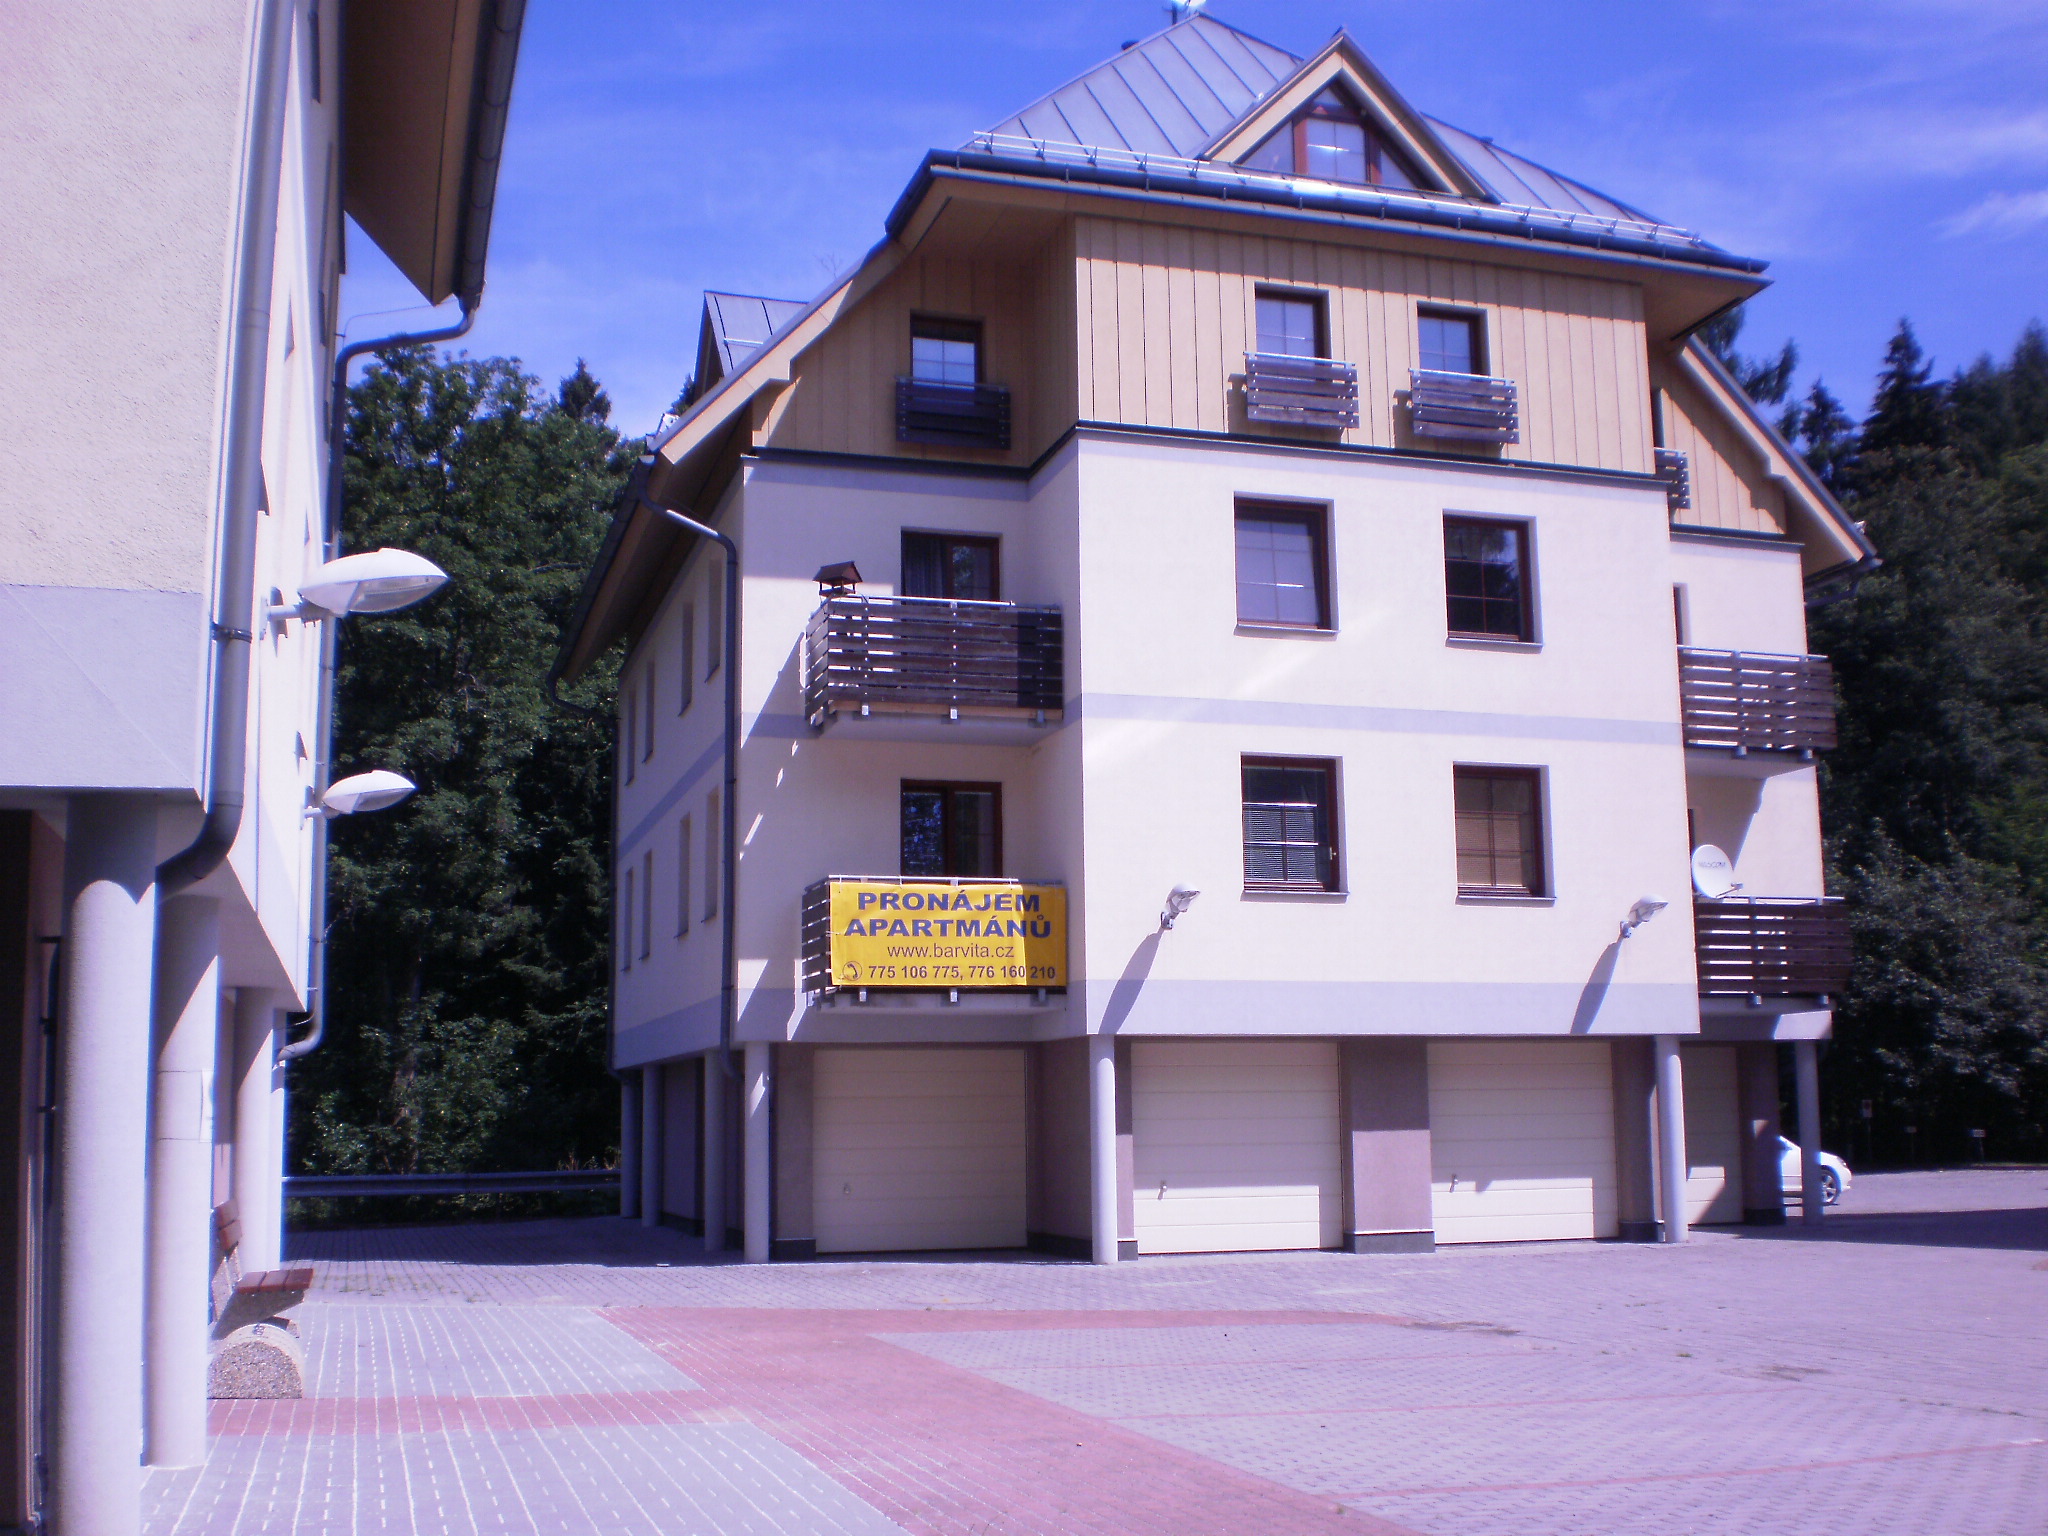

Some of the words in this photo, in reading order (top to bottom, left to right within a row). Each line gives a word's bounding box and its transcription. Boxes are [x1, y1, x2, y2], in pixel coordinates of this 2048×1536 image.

[858, 890, 1040, 912] PRONÁJEM
[844, 915, 1051, 938] APARTMÁNŮ
[887, 943, 1014, 958] www.barvita.cz
[868, 966, 896, 979] 775
[901, 966, 928, 979] 106
[932, 966, 963, 981] 775,
[968, 966, 995, 979] 776
[1001, 966, 1026, 979] 160
[1030, 966, 1056, 979] 210
